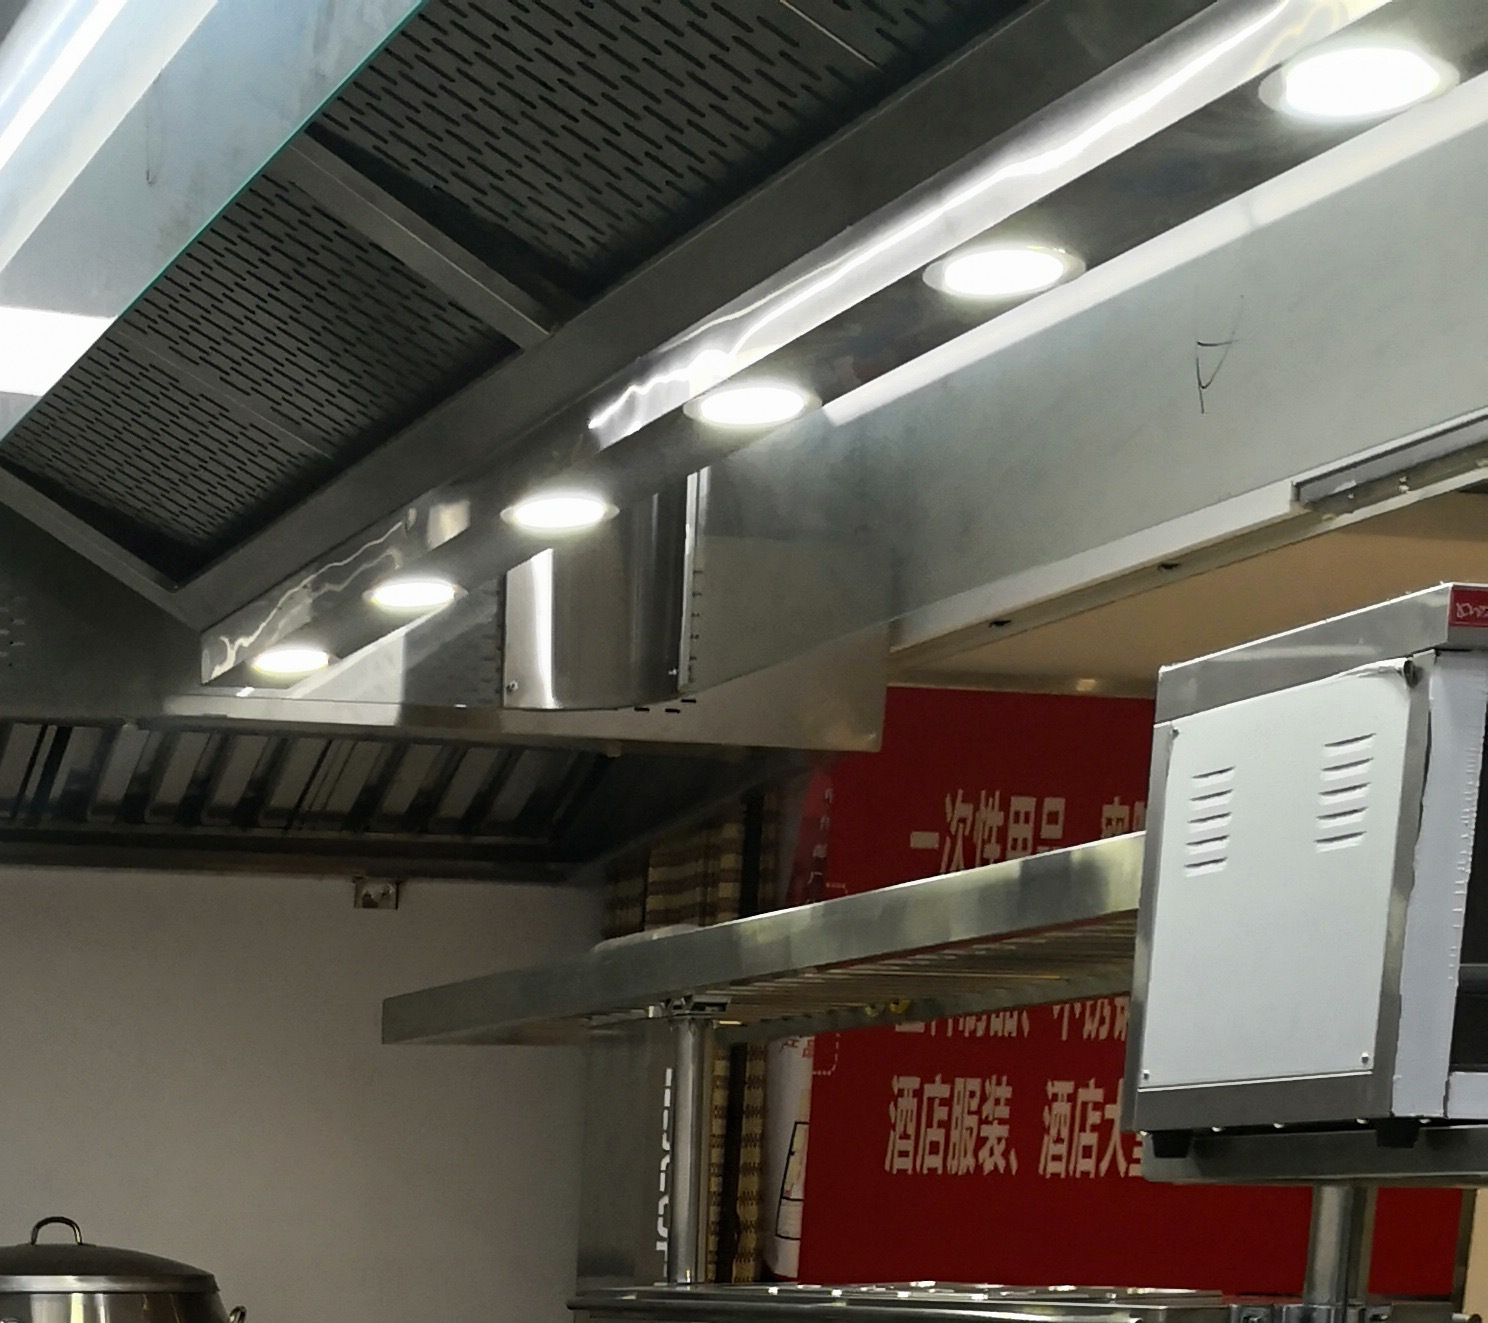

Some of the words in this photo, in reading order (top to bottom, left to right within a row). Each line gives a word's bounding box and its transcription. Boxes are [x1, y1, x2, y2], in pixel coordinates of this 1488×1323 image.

[884, 1072, 1144, 1180] 酒店服装、酒店大
